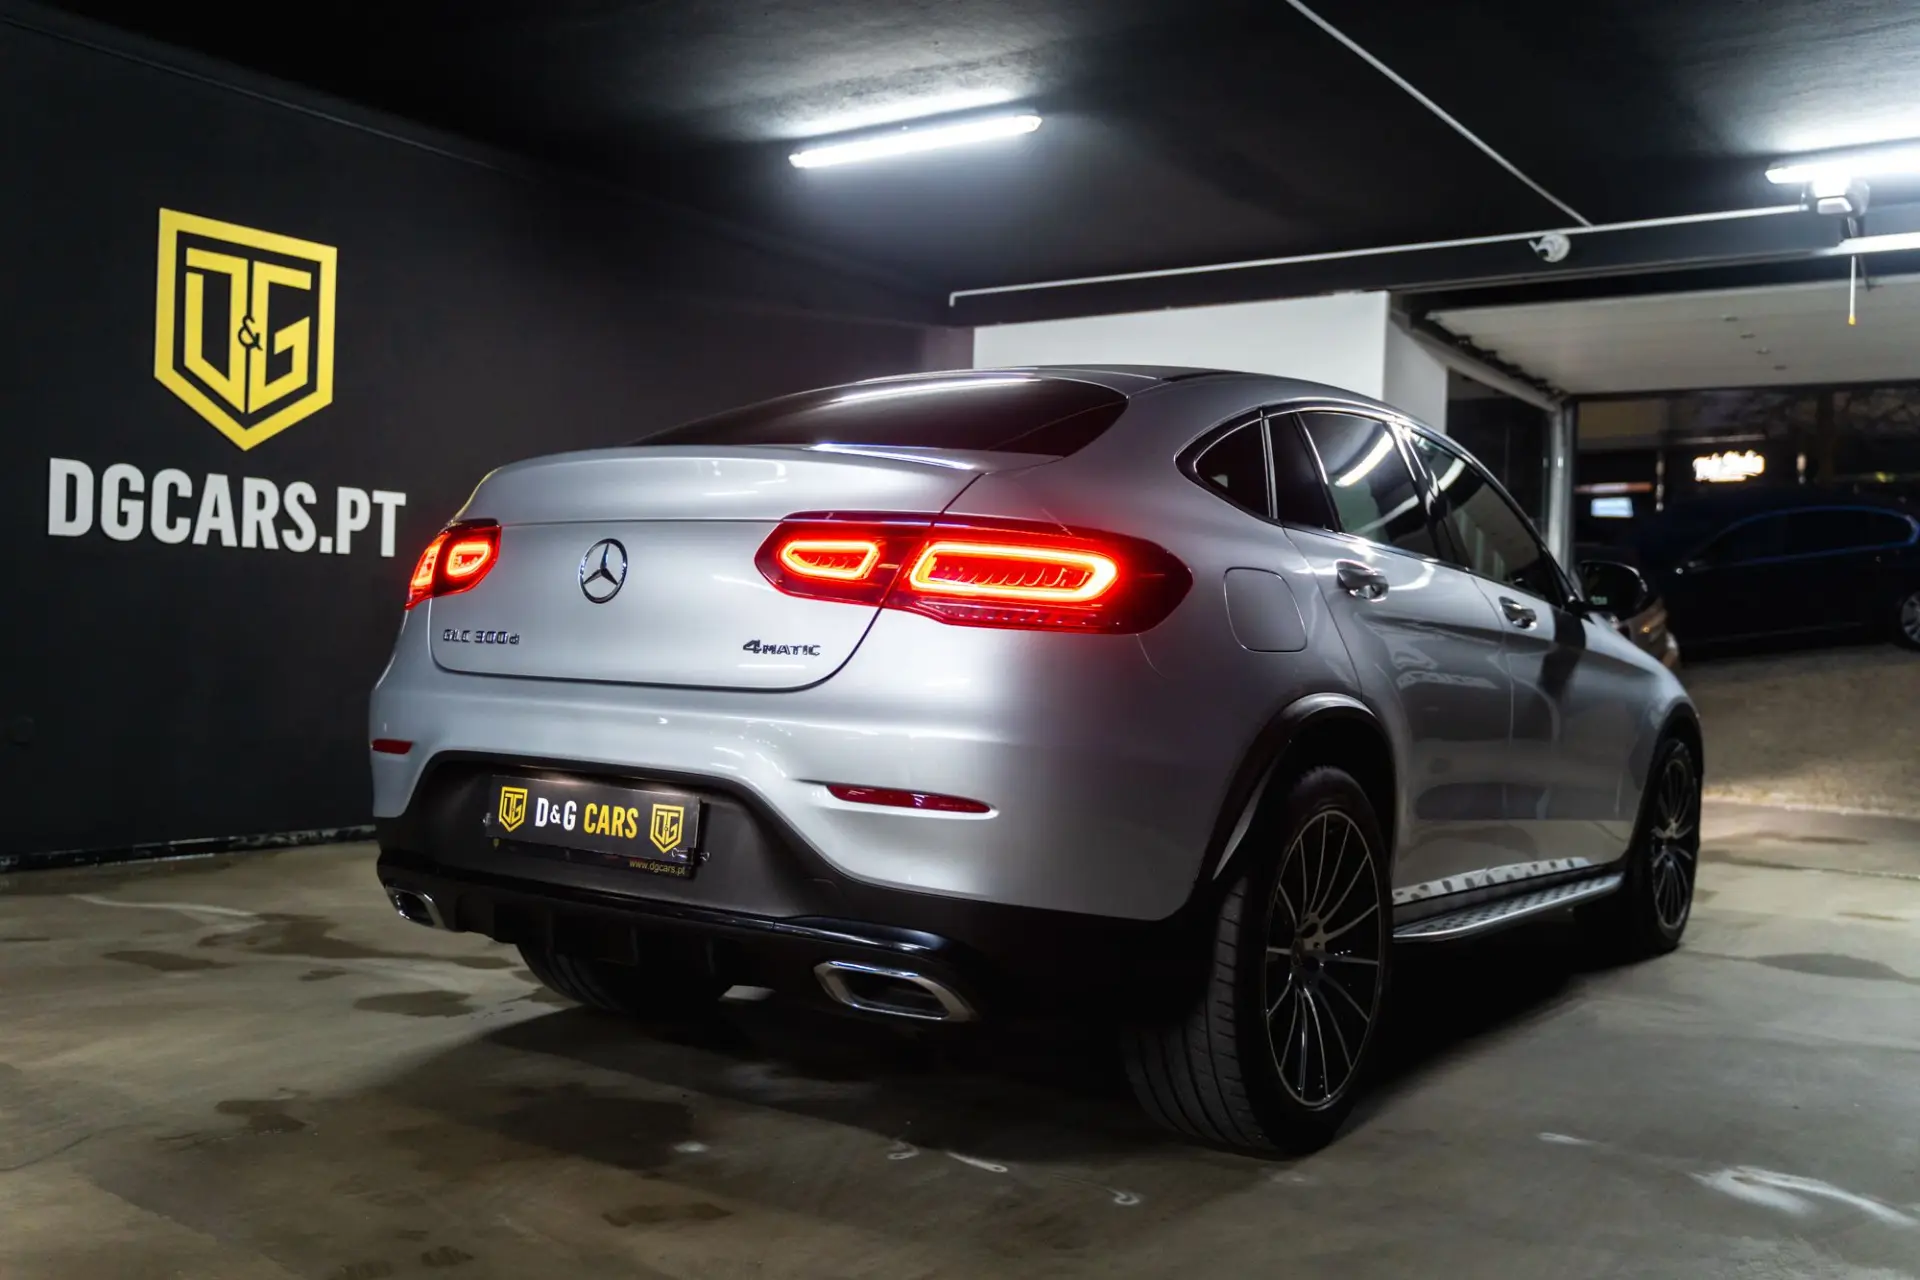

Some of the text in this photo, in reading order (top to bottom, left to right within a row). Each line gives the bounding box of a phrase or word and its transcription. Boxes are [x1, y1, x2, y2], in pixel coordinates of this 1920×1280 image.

[48, 457, 406, 558] DGCARS.PT
[443, 628, 520, 645] GLC 300d
[742, 639, 822, 656] 4MATIC
[535, 797, 639, 839] D&G CARS
